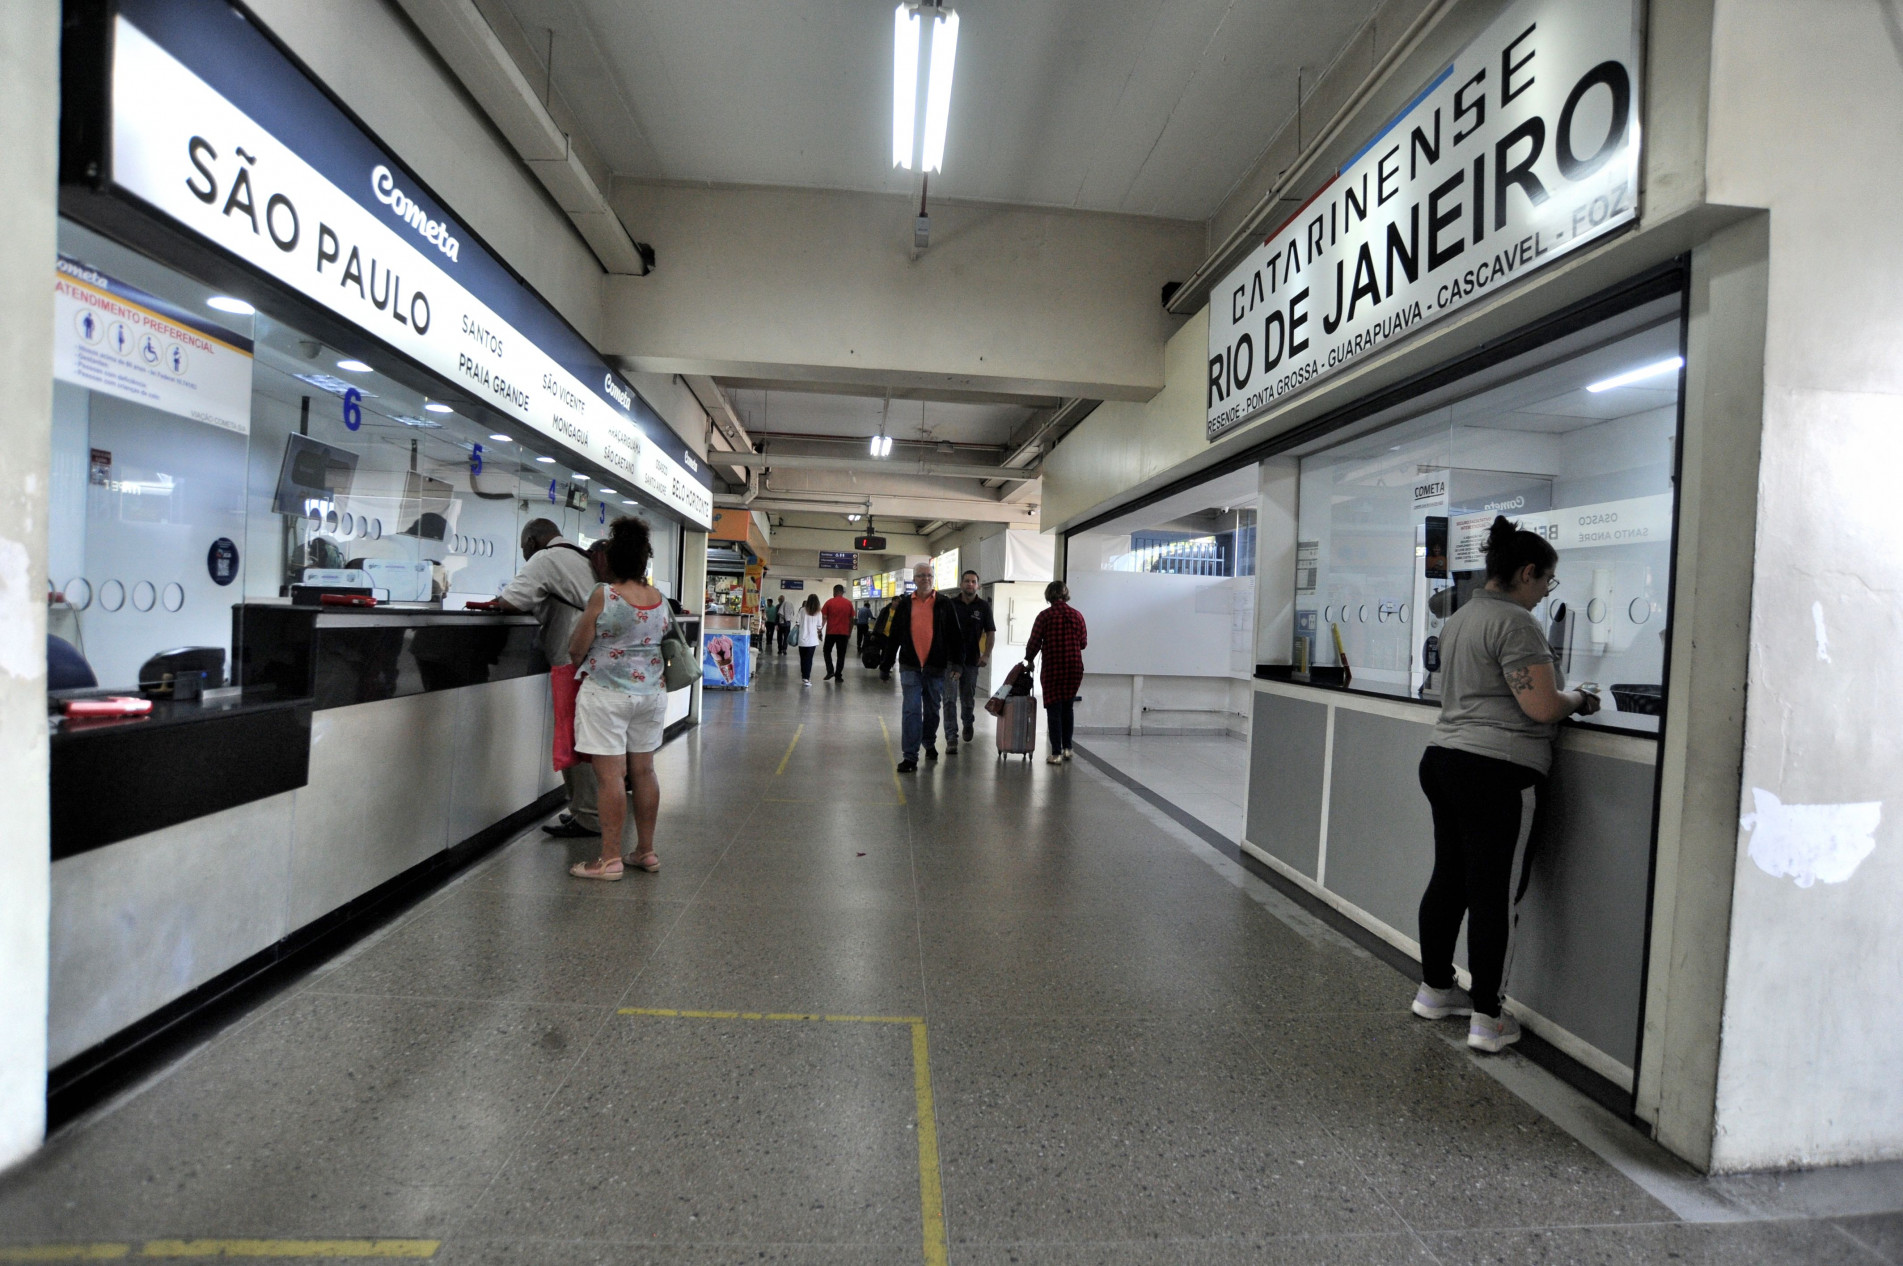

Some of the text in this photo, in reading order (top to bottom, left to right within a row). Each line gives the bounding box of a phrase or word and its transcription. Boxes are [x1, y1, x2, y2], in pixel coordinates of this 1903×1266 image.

[1233, 22, 1537, 326] CATARINENSE
[186, 135, 430, 335] SÃO PAULO
[371, 165, 460, 263] Cometa
[1208, 60, 1631, 409] RIO DE JANEIRO
[57, 259, 108, 289] ometa
[55, 280, 215, 355] ATENDIMENTO PREFERENCIAL
[1208, 404, 1240, 435] RESENDE
[1246, 387, 1275, 412] PONTA
[1276, 359, 1319, 402] GROSSA
[1327, 300, 1423, 369] GUARAPUAVA
[1436, 231, 1548, 310] CASCAVEL
[1571, 181, 1630, 239] FOZ
[461, 314, 503, 358] SANTOS
[458, 352, 529, 412] PRAIA GRANDE
[543, 373, 585, 415] SÃO VICENTE
[604, 373, 631, 411] Cometa
[343, 388, 362, 431] 6
[552, 413, 589, 448] MONGAGUÁ
[470, 443, 482, 475] 5
[603, 445, 635, 475] SÃO CAETANO
[548, 479, 556, 504] 4
[671, 477, 709, 518] BELO HORIZONTE
[1414, 480, 1445, 498] COMETA
[599, 502, 605, 524] 3
